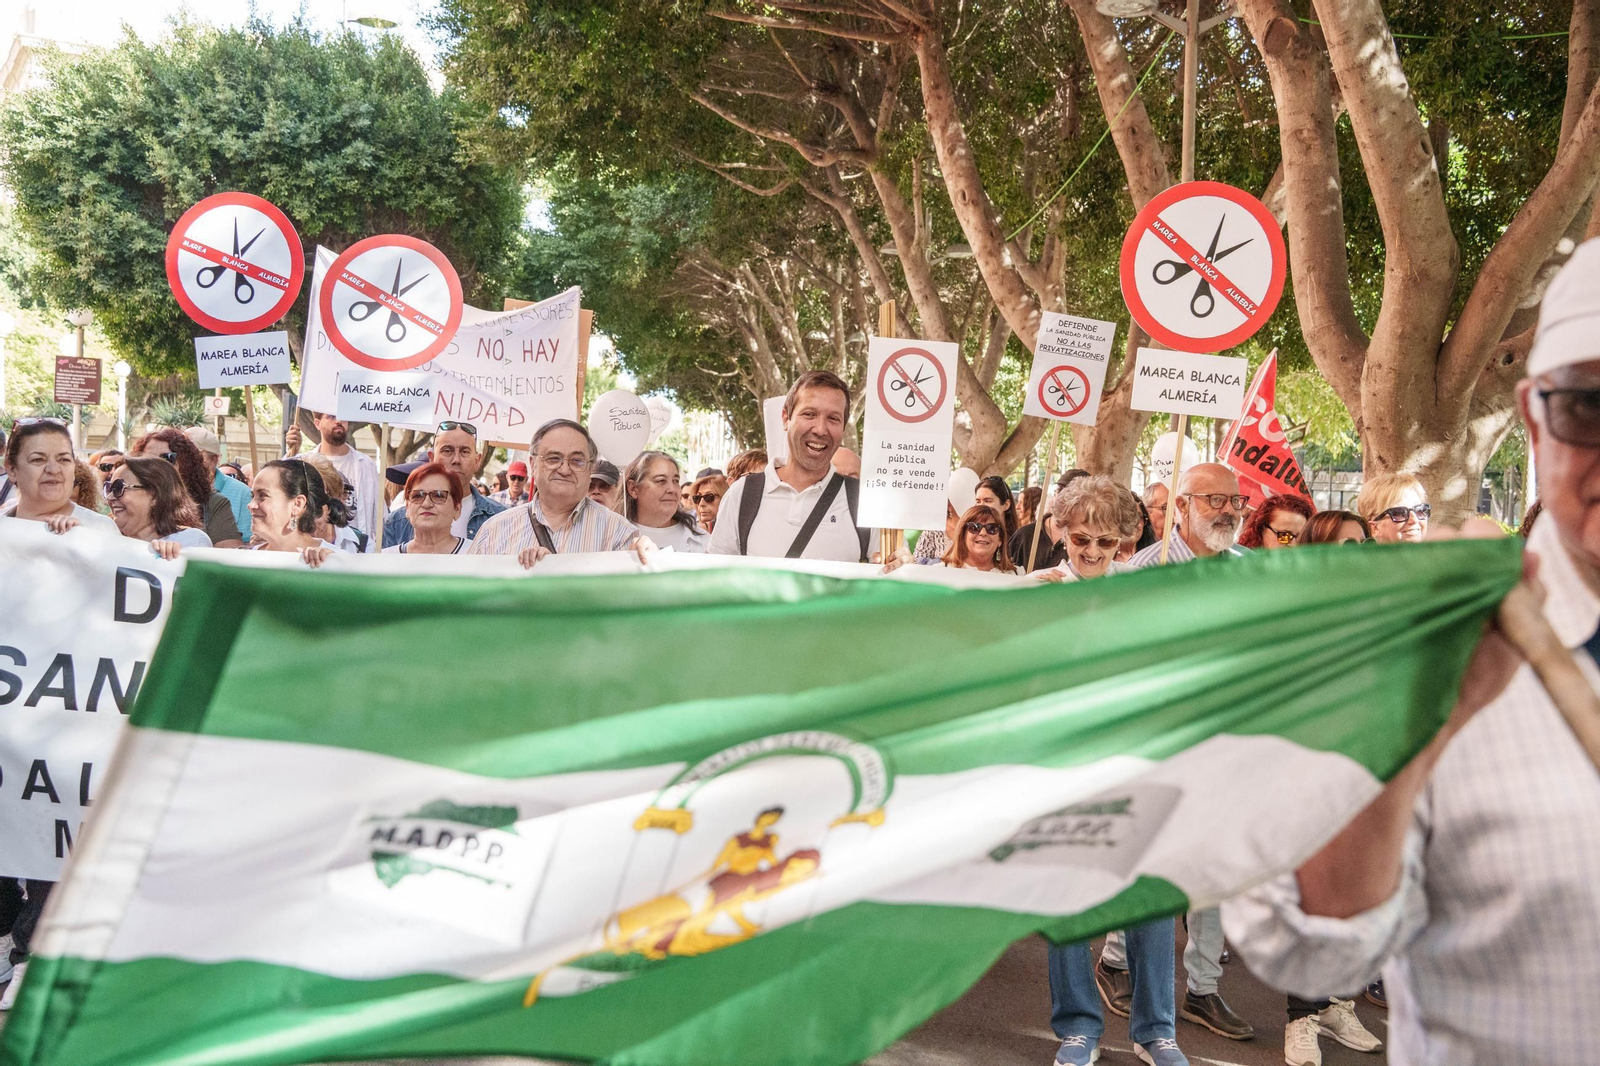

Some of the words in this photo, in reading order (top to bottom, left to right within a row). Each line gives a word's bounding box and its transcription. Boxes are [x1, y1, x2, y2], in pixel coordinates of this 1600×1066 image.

[182, 240, 207, 254] MAREA
[221, 256, 249, 272] BLANCA
[258, 271, 289, 288] ALMERÍA
[1152, 221, 1179, 245] MAREA
[1190, 254, 1219, 281] BLANCA
[1225, 287, 1257, 316] ALMERÍA
[341, 272, 366, 289] MAREA
[378, 293, 405, 312] BLANCA
[413, 314, 444, 334] ALMERÍA
[1058, 319, 1098, 332] DEFIENDE
[1055, 328, 1081, 338] SANIDAD
[1082, 333, 1106, 342] PÚBLICA
[476, 337, 505, 361] NO
[522, 338, 560, 363] HAY
[1056, 337, 1069, 346] NO
[1077, 341, 1092, 349] LAS
[201, 349, 238, 361] MAREA
[242, 346, 285, 358] BLANCA
[1039, 343, 1105, 361] PRIVATIZACIONES
[220, 361, 269, 376] ALMERÍA
[1140, 365, 1185, 380] MAREA
[1190, 370, 1240, 386] BLANCA
[341, 384, 381, 395] MAREA
[386, 386, 431, 398] BLANCA
[1159, 388, 1217, 404] ALMERÍA
[359, 400, 411, 413] ALMERÍA
[608, 406, 647, 418] Sanidad
[609, 417, 642, 432] Pública
[881, 440, 892, 450] La
[897, 443, 935, 452] sanidad
[888, 454, 926, 465] pública
[876, 467, 888, 475] no
[892, 468, 904, 476] se
[909, 469, 936, 478] vende
[866, 479, 886, 488] ¡¡Se
[891, 480, 944, 491] defiende!!
